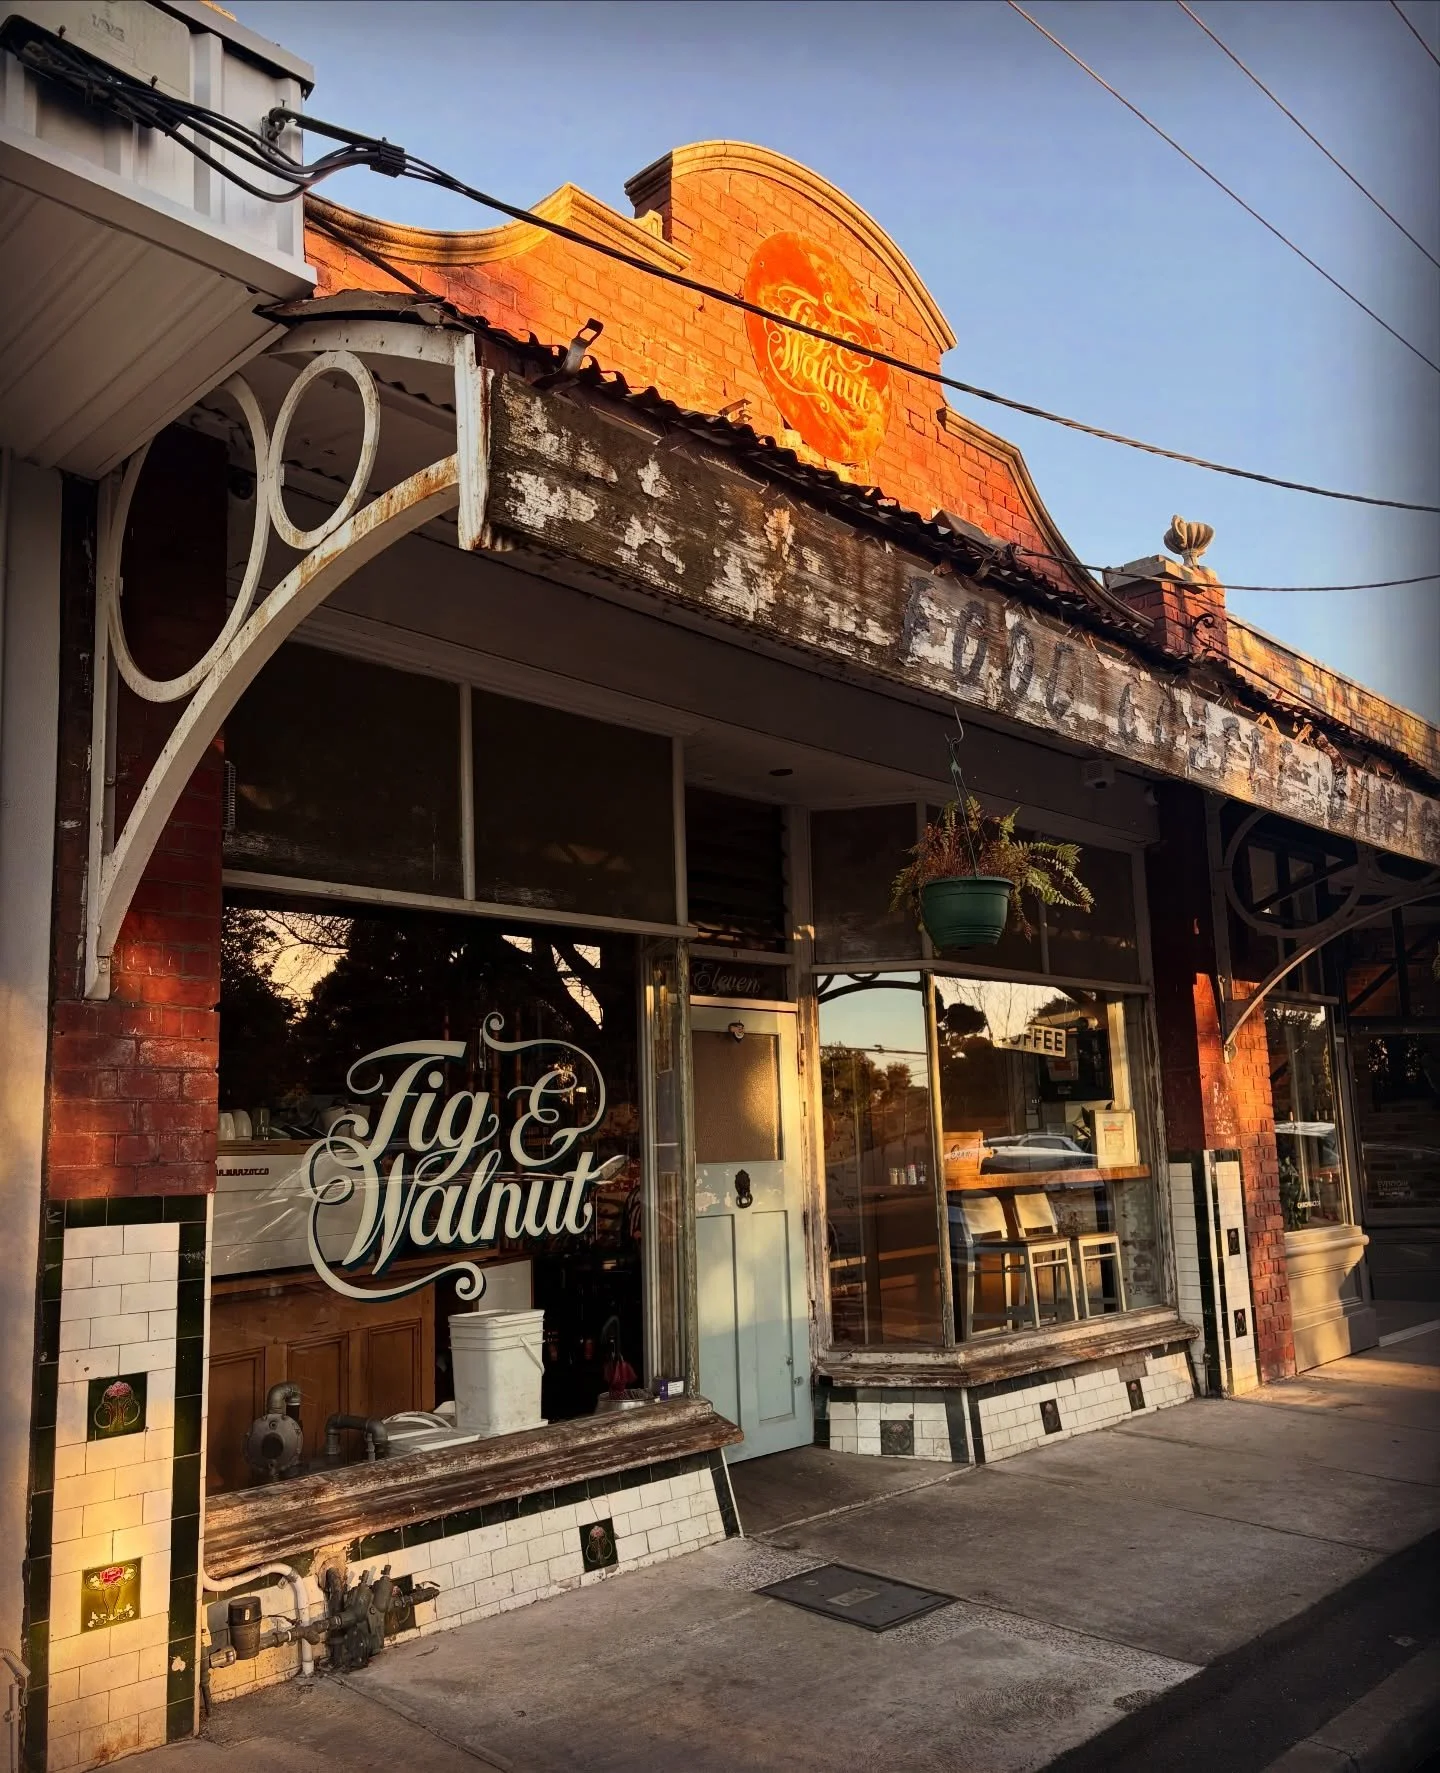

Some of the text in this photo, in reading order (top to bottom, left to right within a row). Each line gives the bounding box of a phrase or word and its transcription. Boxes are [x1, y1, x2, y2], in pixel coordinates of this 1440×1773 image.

[763, 316, 874, 413] Walnut
[693, 961, 761, 995] Eleven
[999, 1027, 1063, 1051] OFFEE
[328, 1039, 499, 1186] Fig
[302, 1137, 618, 1300] Walnut
